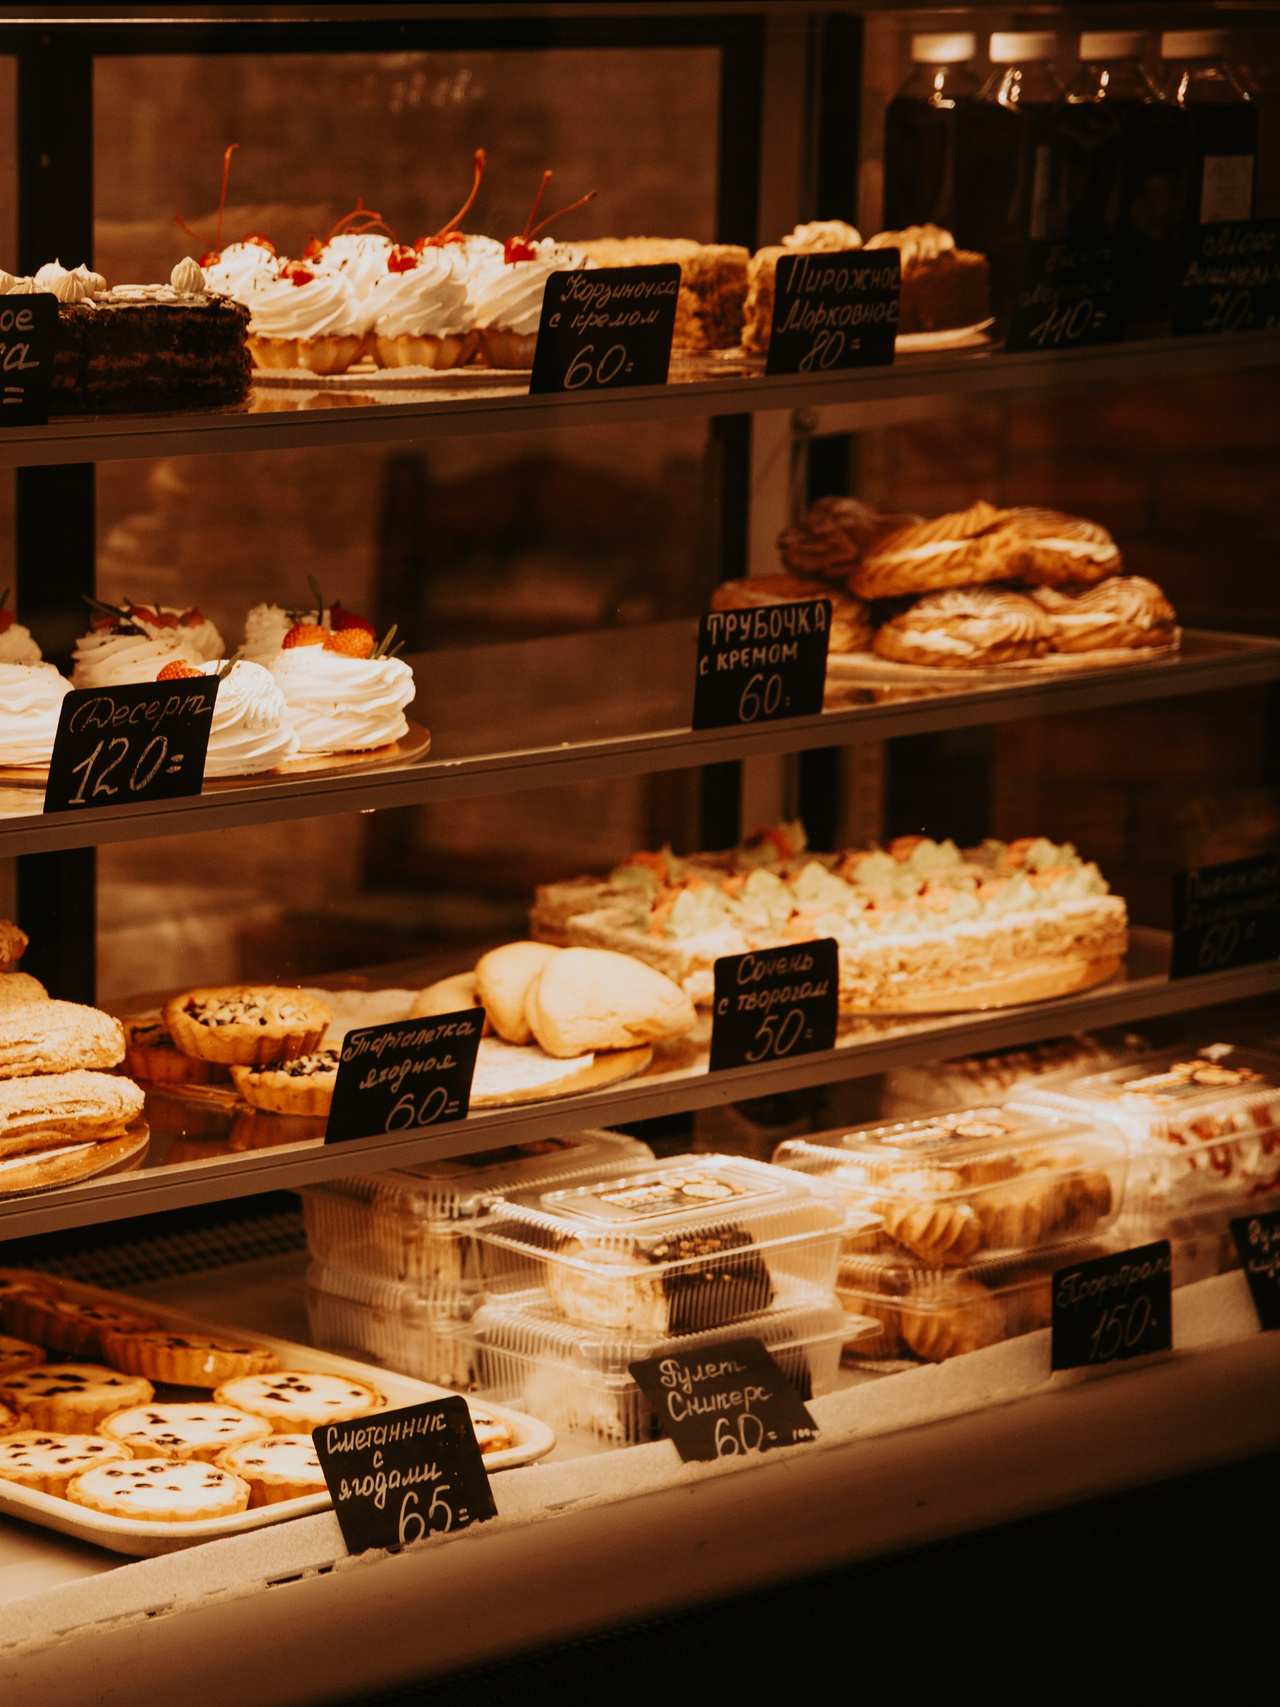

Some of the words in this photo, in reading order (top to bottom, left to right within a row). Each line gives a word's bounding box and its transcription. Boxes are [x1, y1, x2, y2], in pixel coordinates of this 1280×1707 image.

[560, 272, 678, 311] Корзиночка
[785, 255, 900, 294] Пирожное
[570, 308, 660, 336] кремом
[706, 601, 827, 647] ТРУБОЧКА
[69, 694, 212, 734] Десерт
[658, 1358, 748, 1395] Рулет
[667, 1386, 774, 1422] Сникерс
[326, 1412, 447, 1455] Сметанник
[338, 1461, 443, 1510] ягодами
